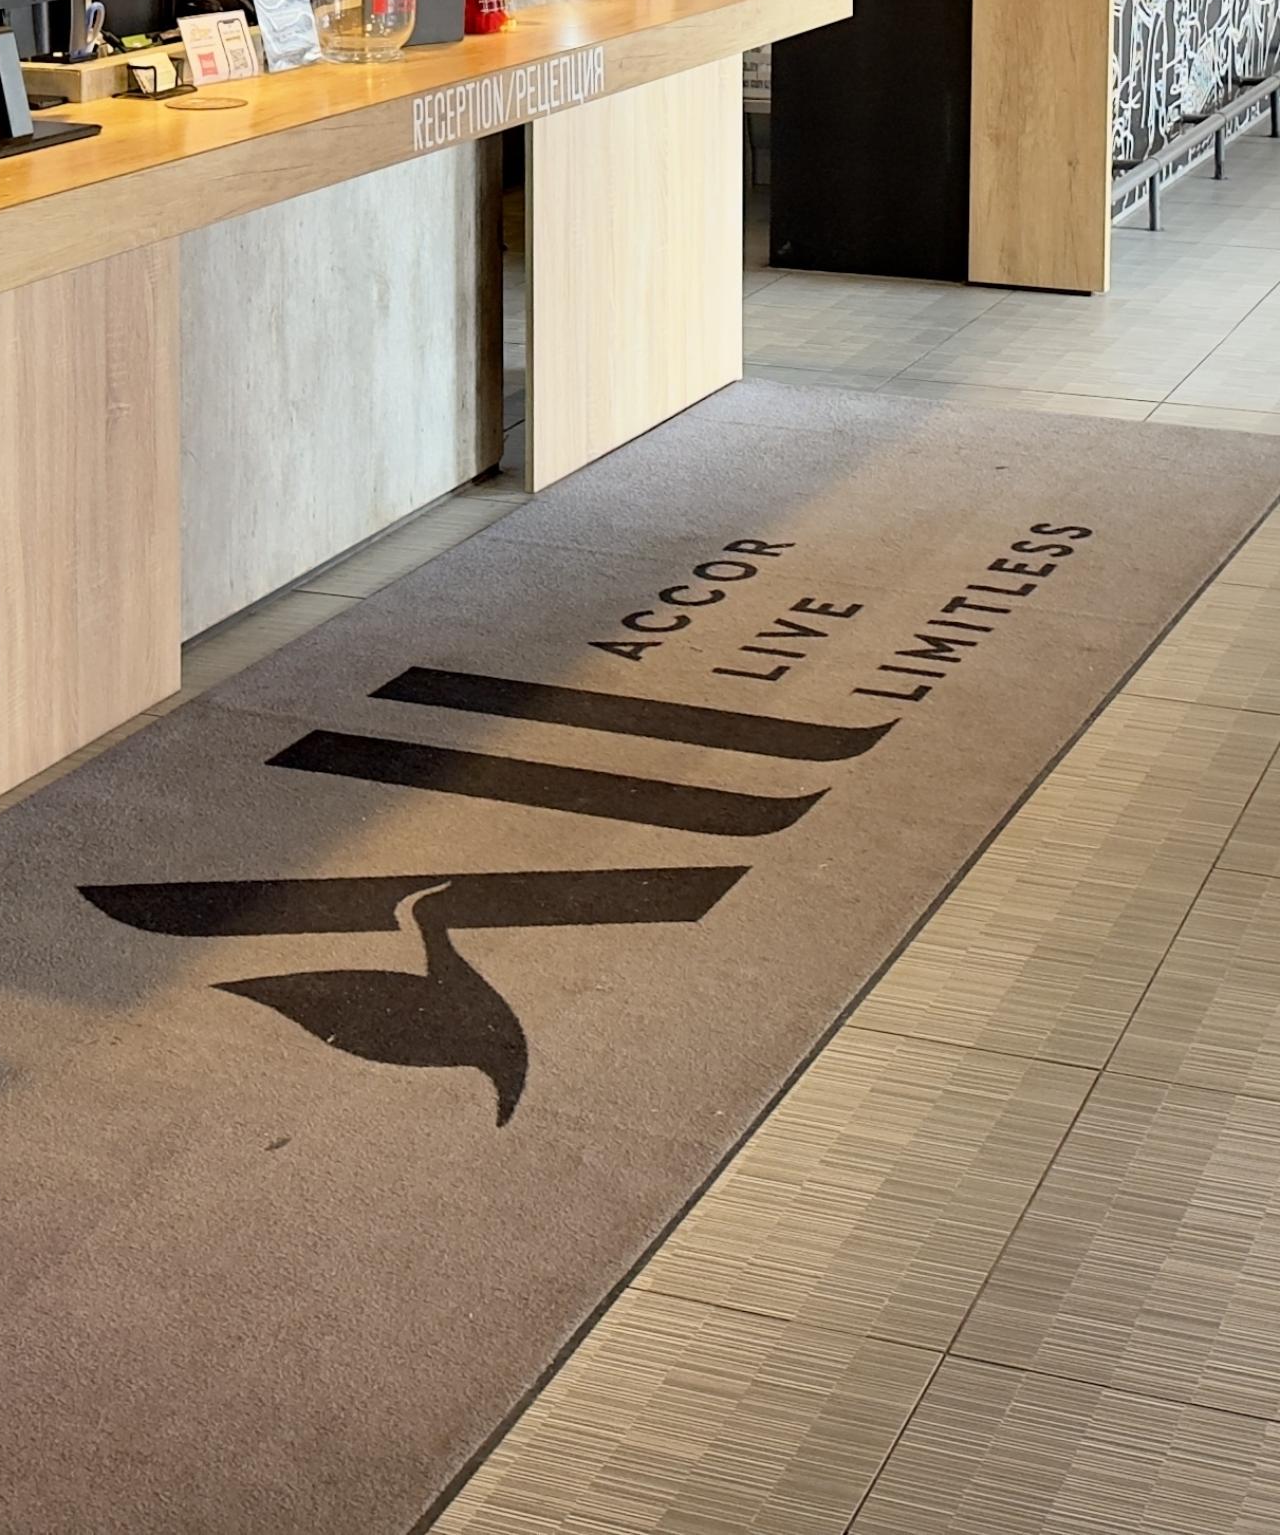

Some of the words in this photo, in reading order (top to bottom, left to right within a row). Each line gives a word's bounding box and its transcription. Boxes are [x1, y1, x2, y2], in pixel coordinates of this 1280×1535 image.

[588, 537, 797, 661] ACCOR
[710, 595, 864, 683] LIVE
[849, 521, 1094, 704] LIMITLESS
